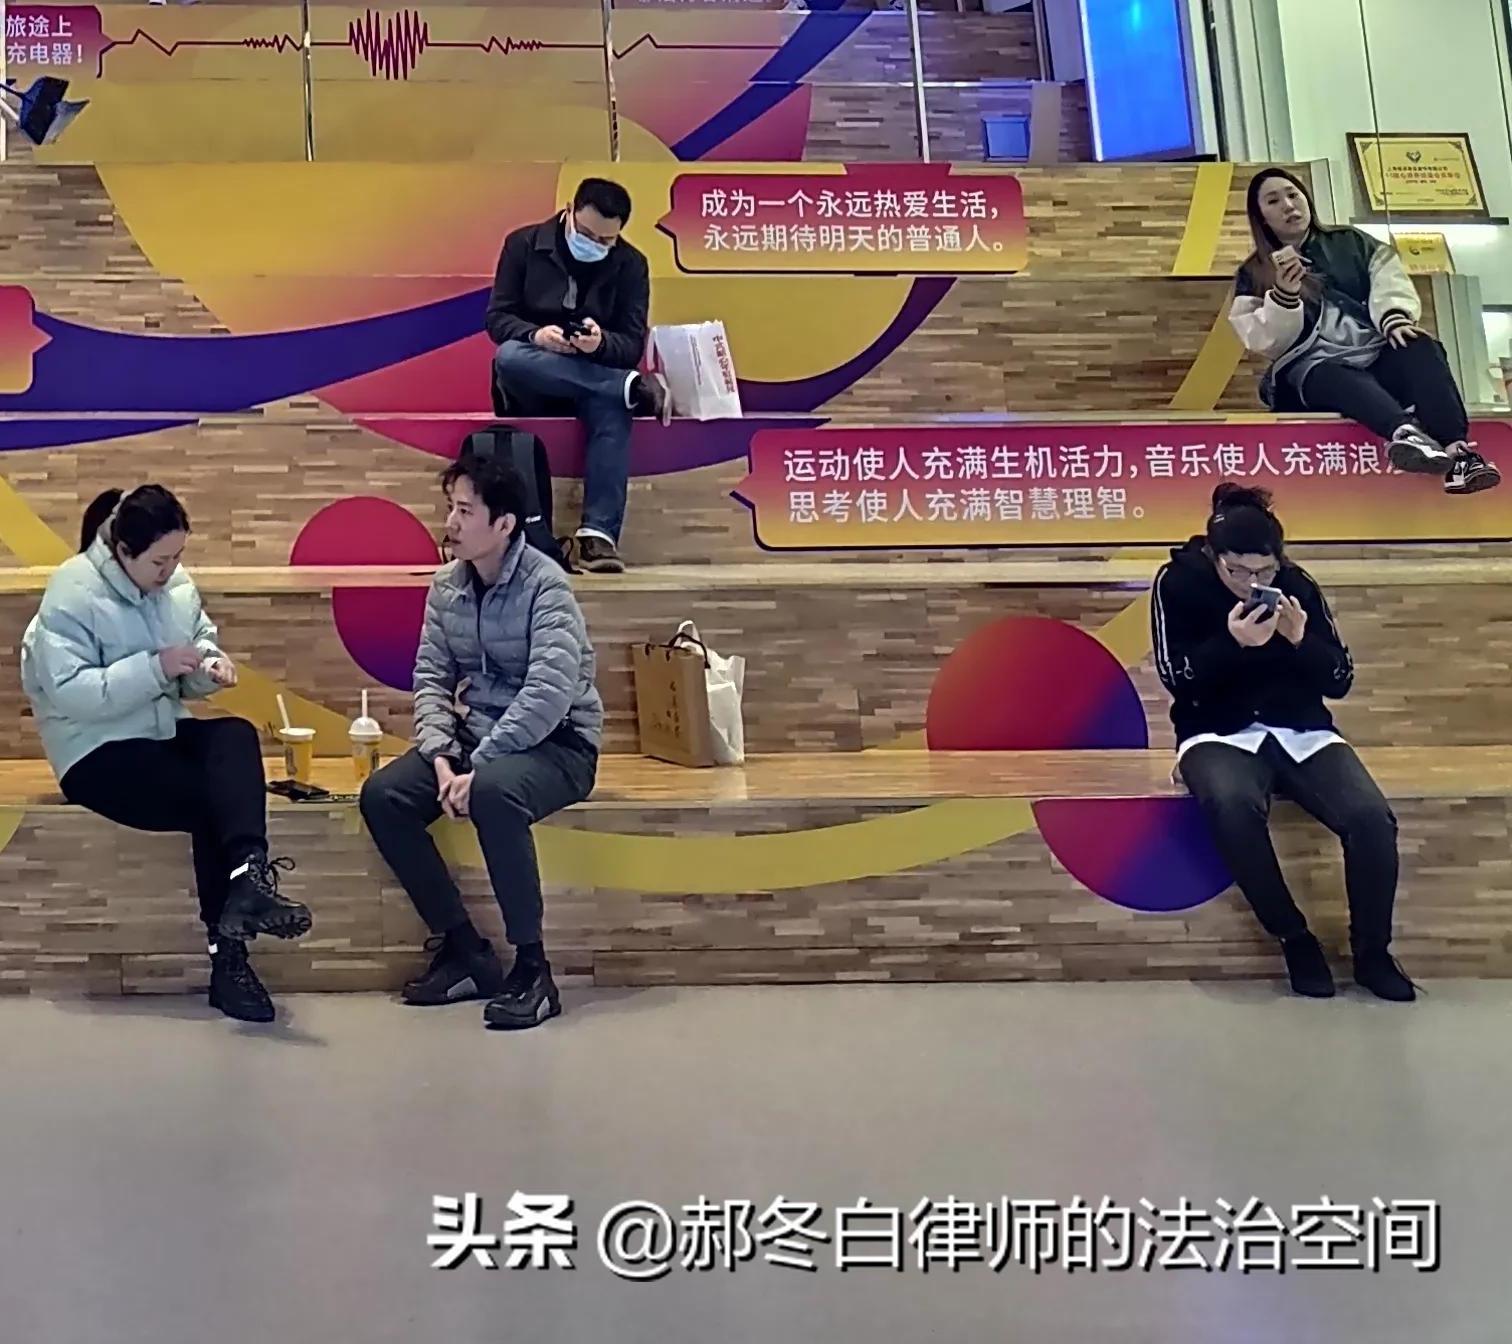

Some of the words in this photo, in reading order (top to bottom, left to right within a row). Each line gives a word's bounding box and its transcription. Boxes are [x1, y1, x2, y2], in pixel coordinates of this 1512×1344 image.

[701, 189, 1000, 220] 成为一个永远热爱生活，
[703, 224, 1005, 254] 永远期待明天的普通人。
[789, 485, 1145, 524] 思考使人充满智慧理智。
